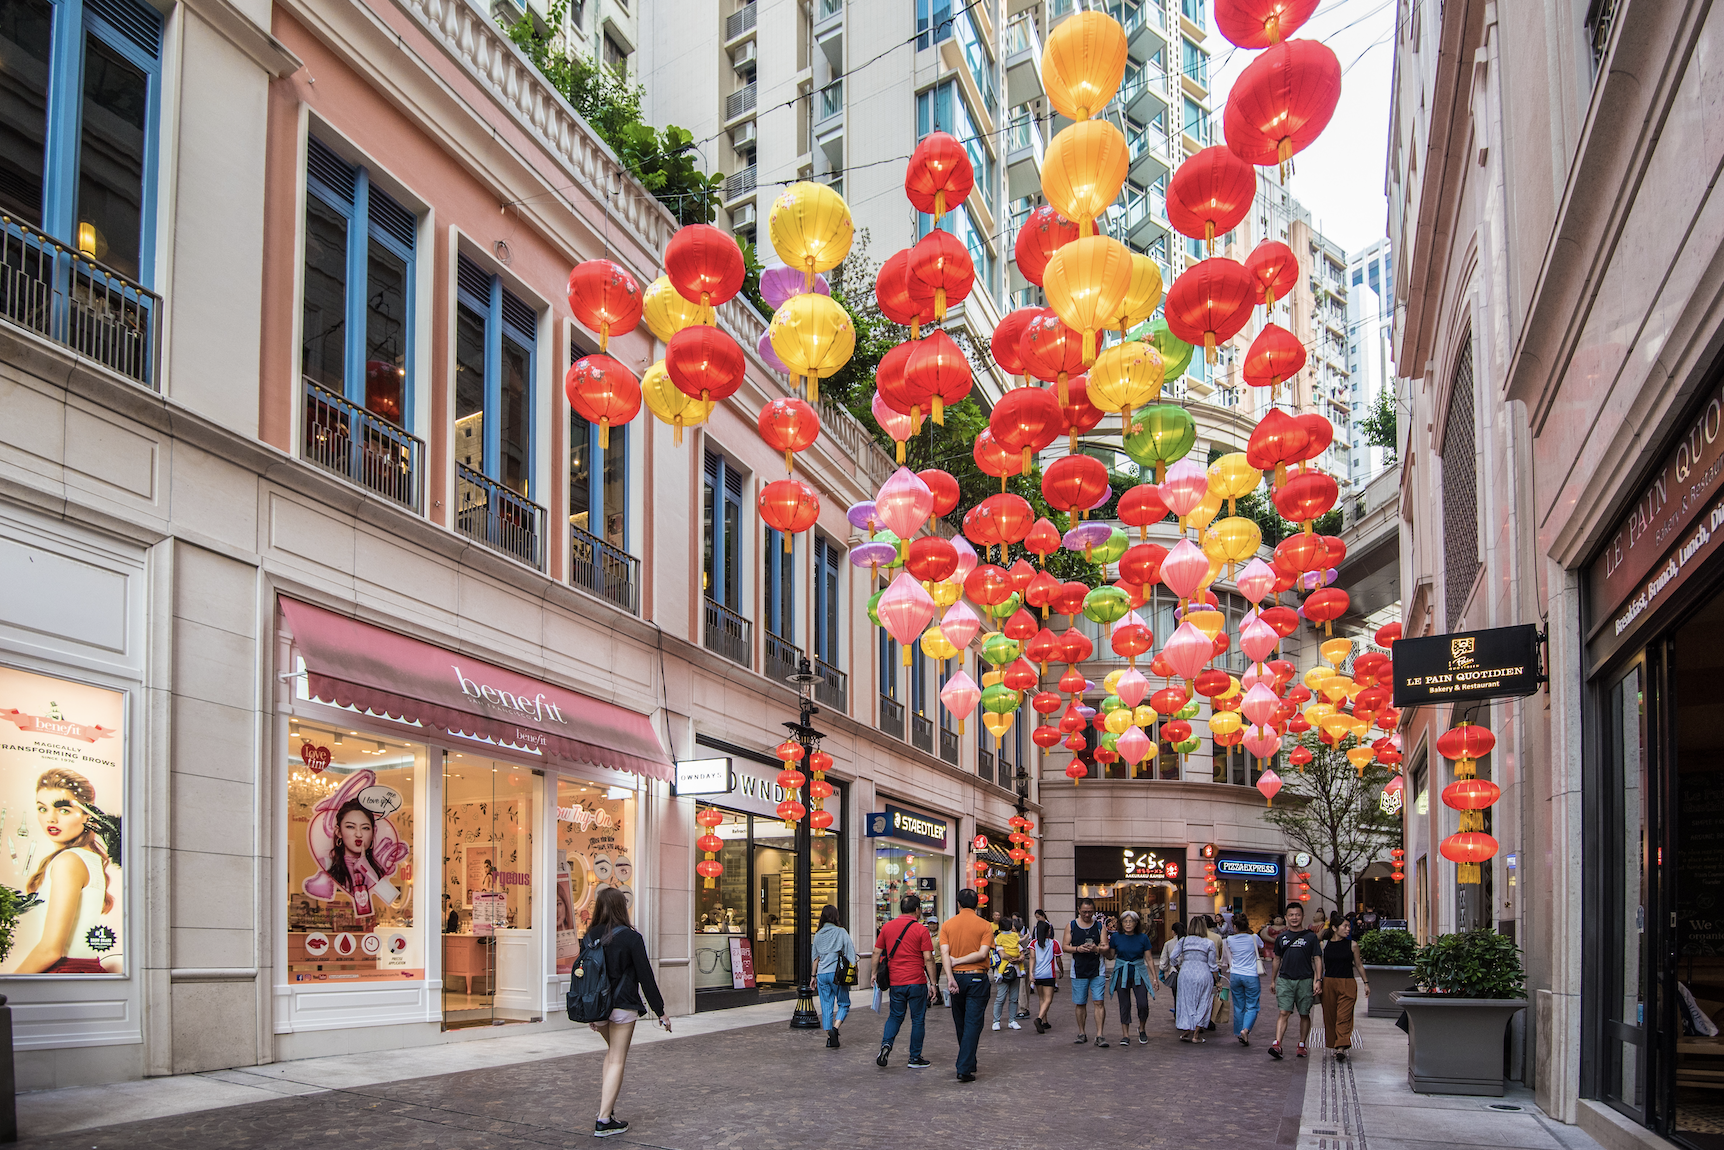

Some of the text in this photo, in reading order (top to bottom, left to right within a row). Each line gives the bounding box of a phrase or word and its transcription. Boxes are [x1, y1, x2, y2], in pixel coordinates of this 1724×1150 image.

[1605, 386, 1724, 579] LE PAIN QUO
[1655, 511, 1680, 546] Bakery
[1682, 496, 1688, 514] &
[1615, 591, 1648, 636] Breakfast,
[1648, 557, 1680, 601] Brunch,
[1679, 524, 1711, 568] Lunch,
[1406, 666, 1524, 686] LE PAIN QUOTIDIEN
[451, 665, 568, 724] benefit
[1429, 685, 1453, 694] Bakery
[1462, 680, 1500, 691] Restaurant
[35, 717, 82, 736] benefit
[34, 741, 82, 752] MAGICALLY
[516, 728, 548, 746] benefit
[82, 755, 116, 767] BROWS
[680, 772, 722, 780] OWNDAYS
[573, 805, 612, 831] Try-On
[902, 816, 945, 840] STAEDTLER
[1123, 849, 1165, 874] らくらく
[1222, 862, 1276, 874] PIZZAEXPRESS
[1689, 919, 1712, 930] We
